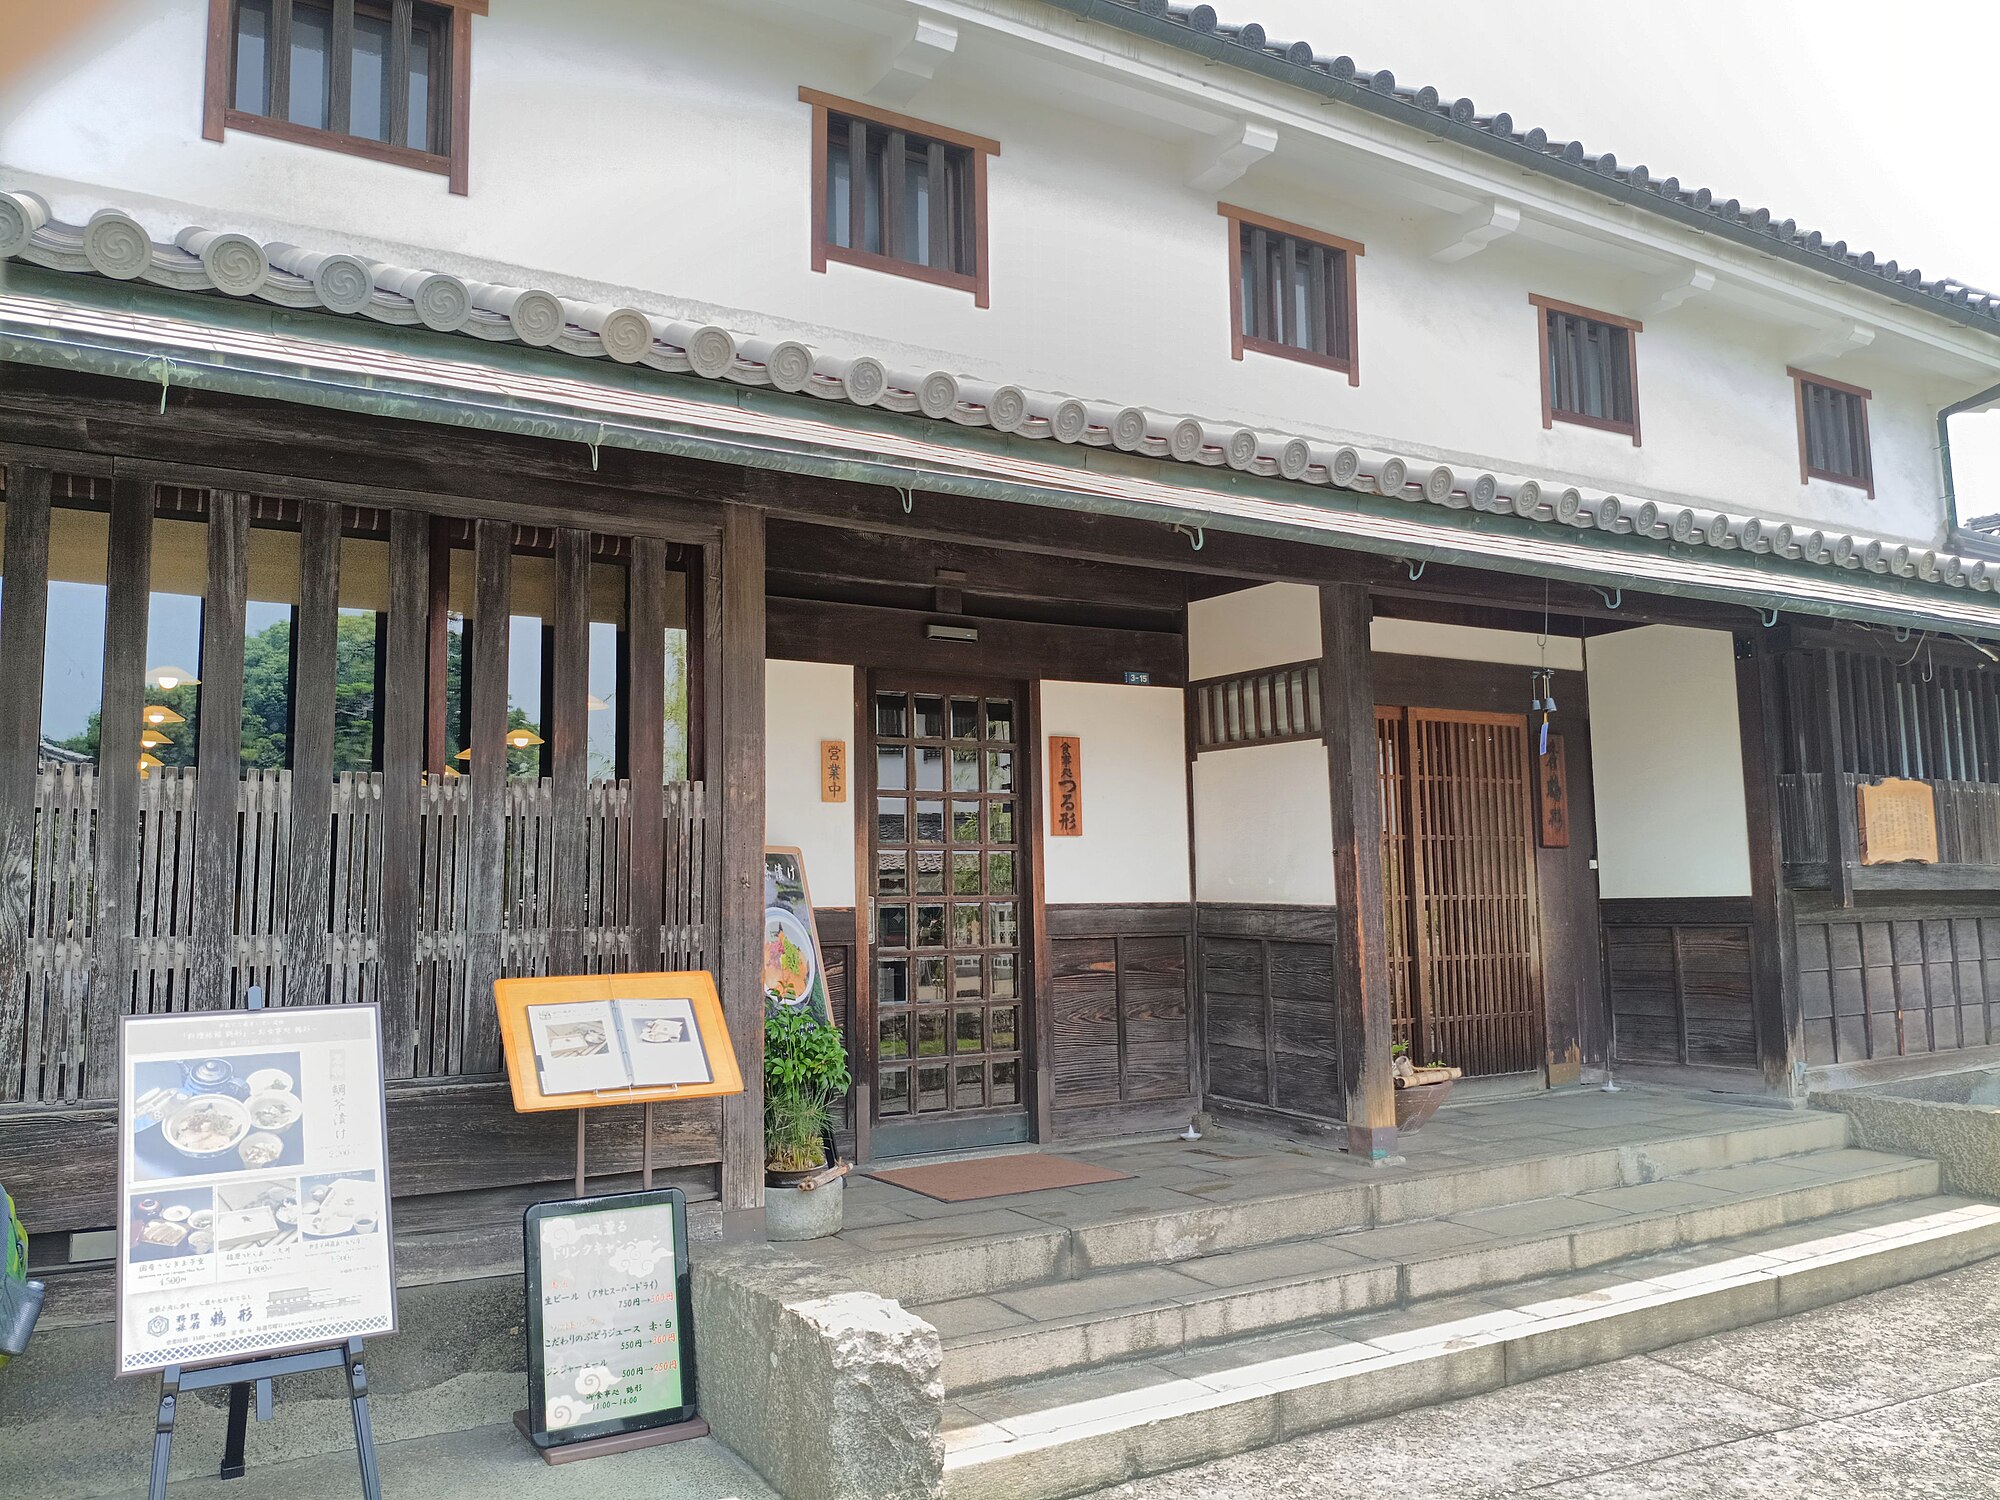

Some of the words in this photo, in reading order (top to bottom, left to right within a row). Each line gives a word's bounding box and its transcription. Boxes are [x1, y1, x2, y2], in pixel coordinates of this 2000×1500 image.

[1130, 674, 1147, 683] 3-15
[828, 746, 841, 798] 営業中
[544, 1292, 579, 1306] 生ビール
[618, 1297, 640, 1308] 750円
[544, 1325, 641, 1348] こだわりのぶどうジュース
[620, 1339, 643, 1351] 550円
[546, 1359, 608, 1376] ジンジャーエール
[622, 1366, 644, 1378] 500円
[653, 1359, 677, 1372] 250円
